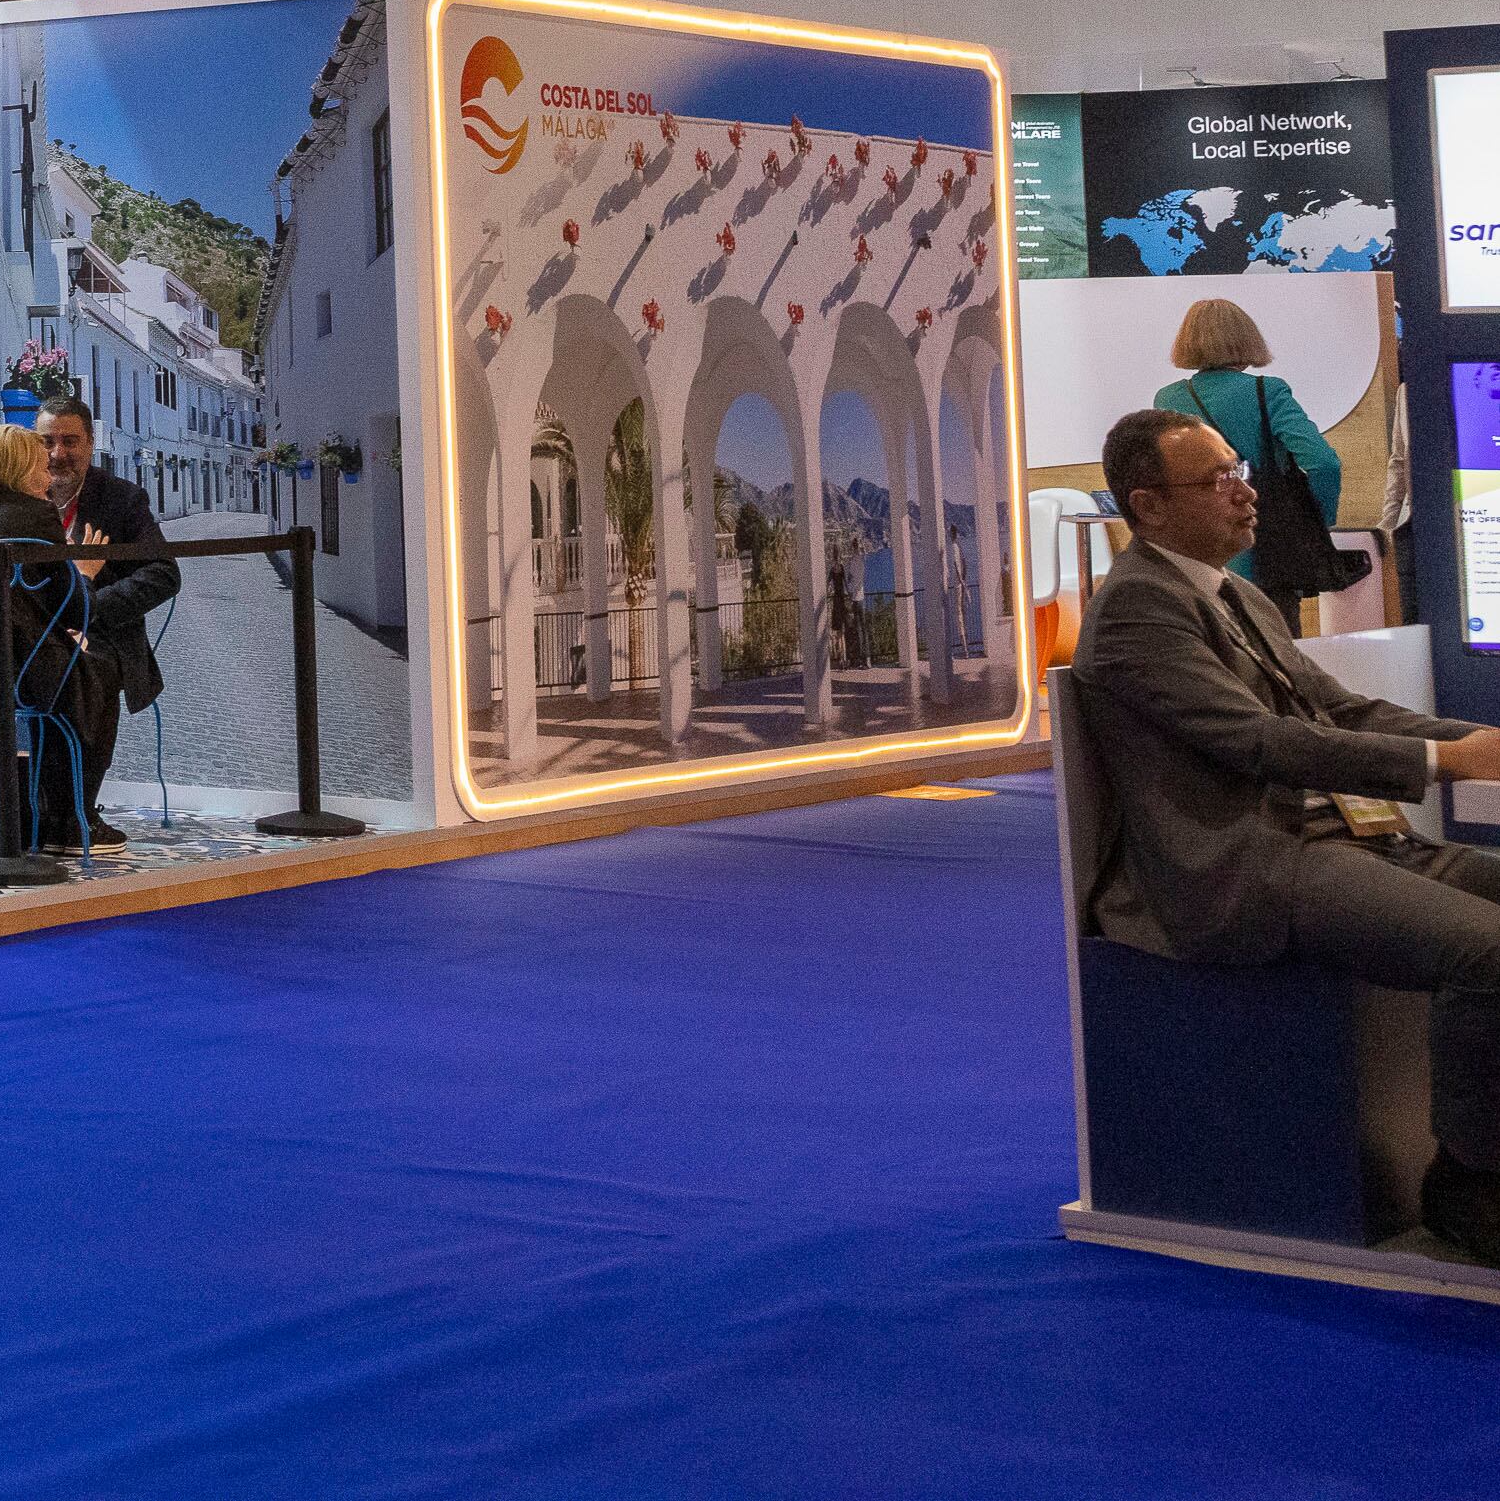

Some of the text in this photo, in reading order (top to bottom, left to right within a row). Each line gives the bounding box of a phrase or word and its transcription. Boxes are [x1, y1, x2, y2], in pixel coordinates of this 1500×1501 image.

[540, 83, 658, 117] COSTA DEL SOL
[541, 110, 609, 142] MÁLAGA
[1187, 110, 1353, 135] Global Network,
[1191, 136, 1352, 160] Local Expertise
